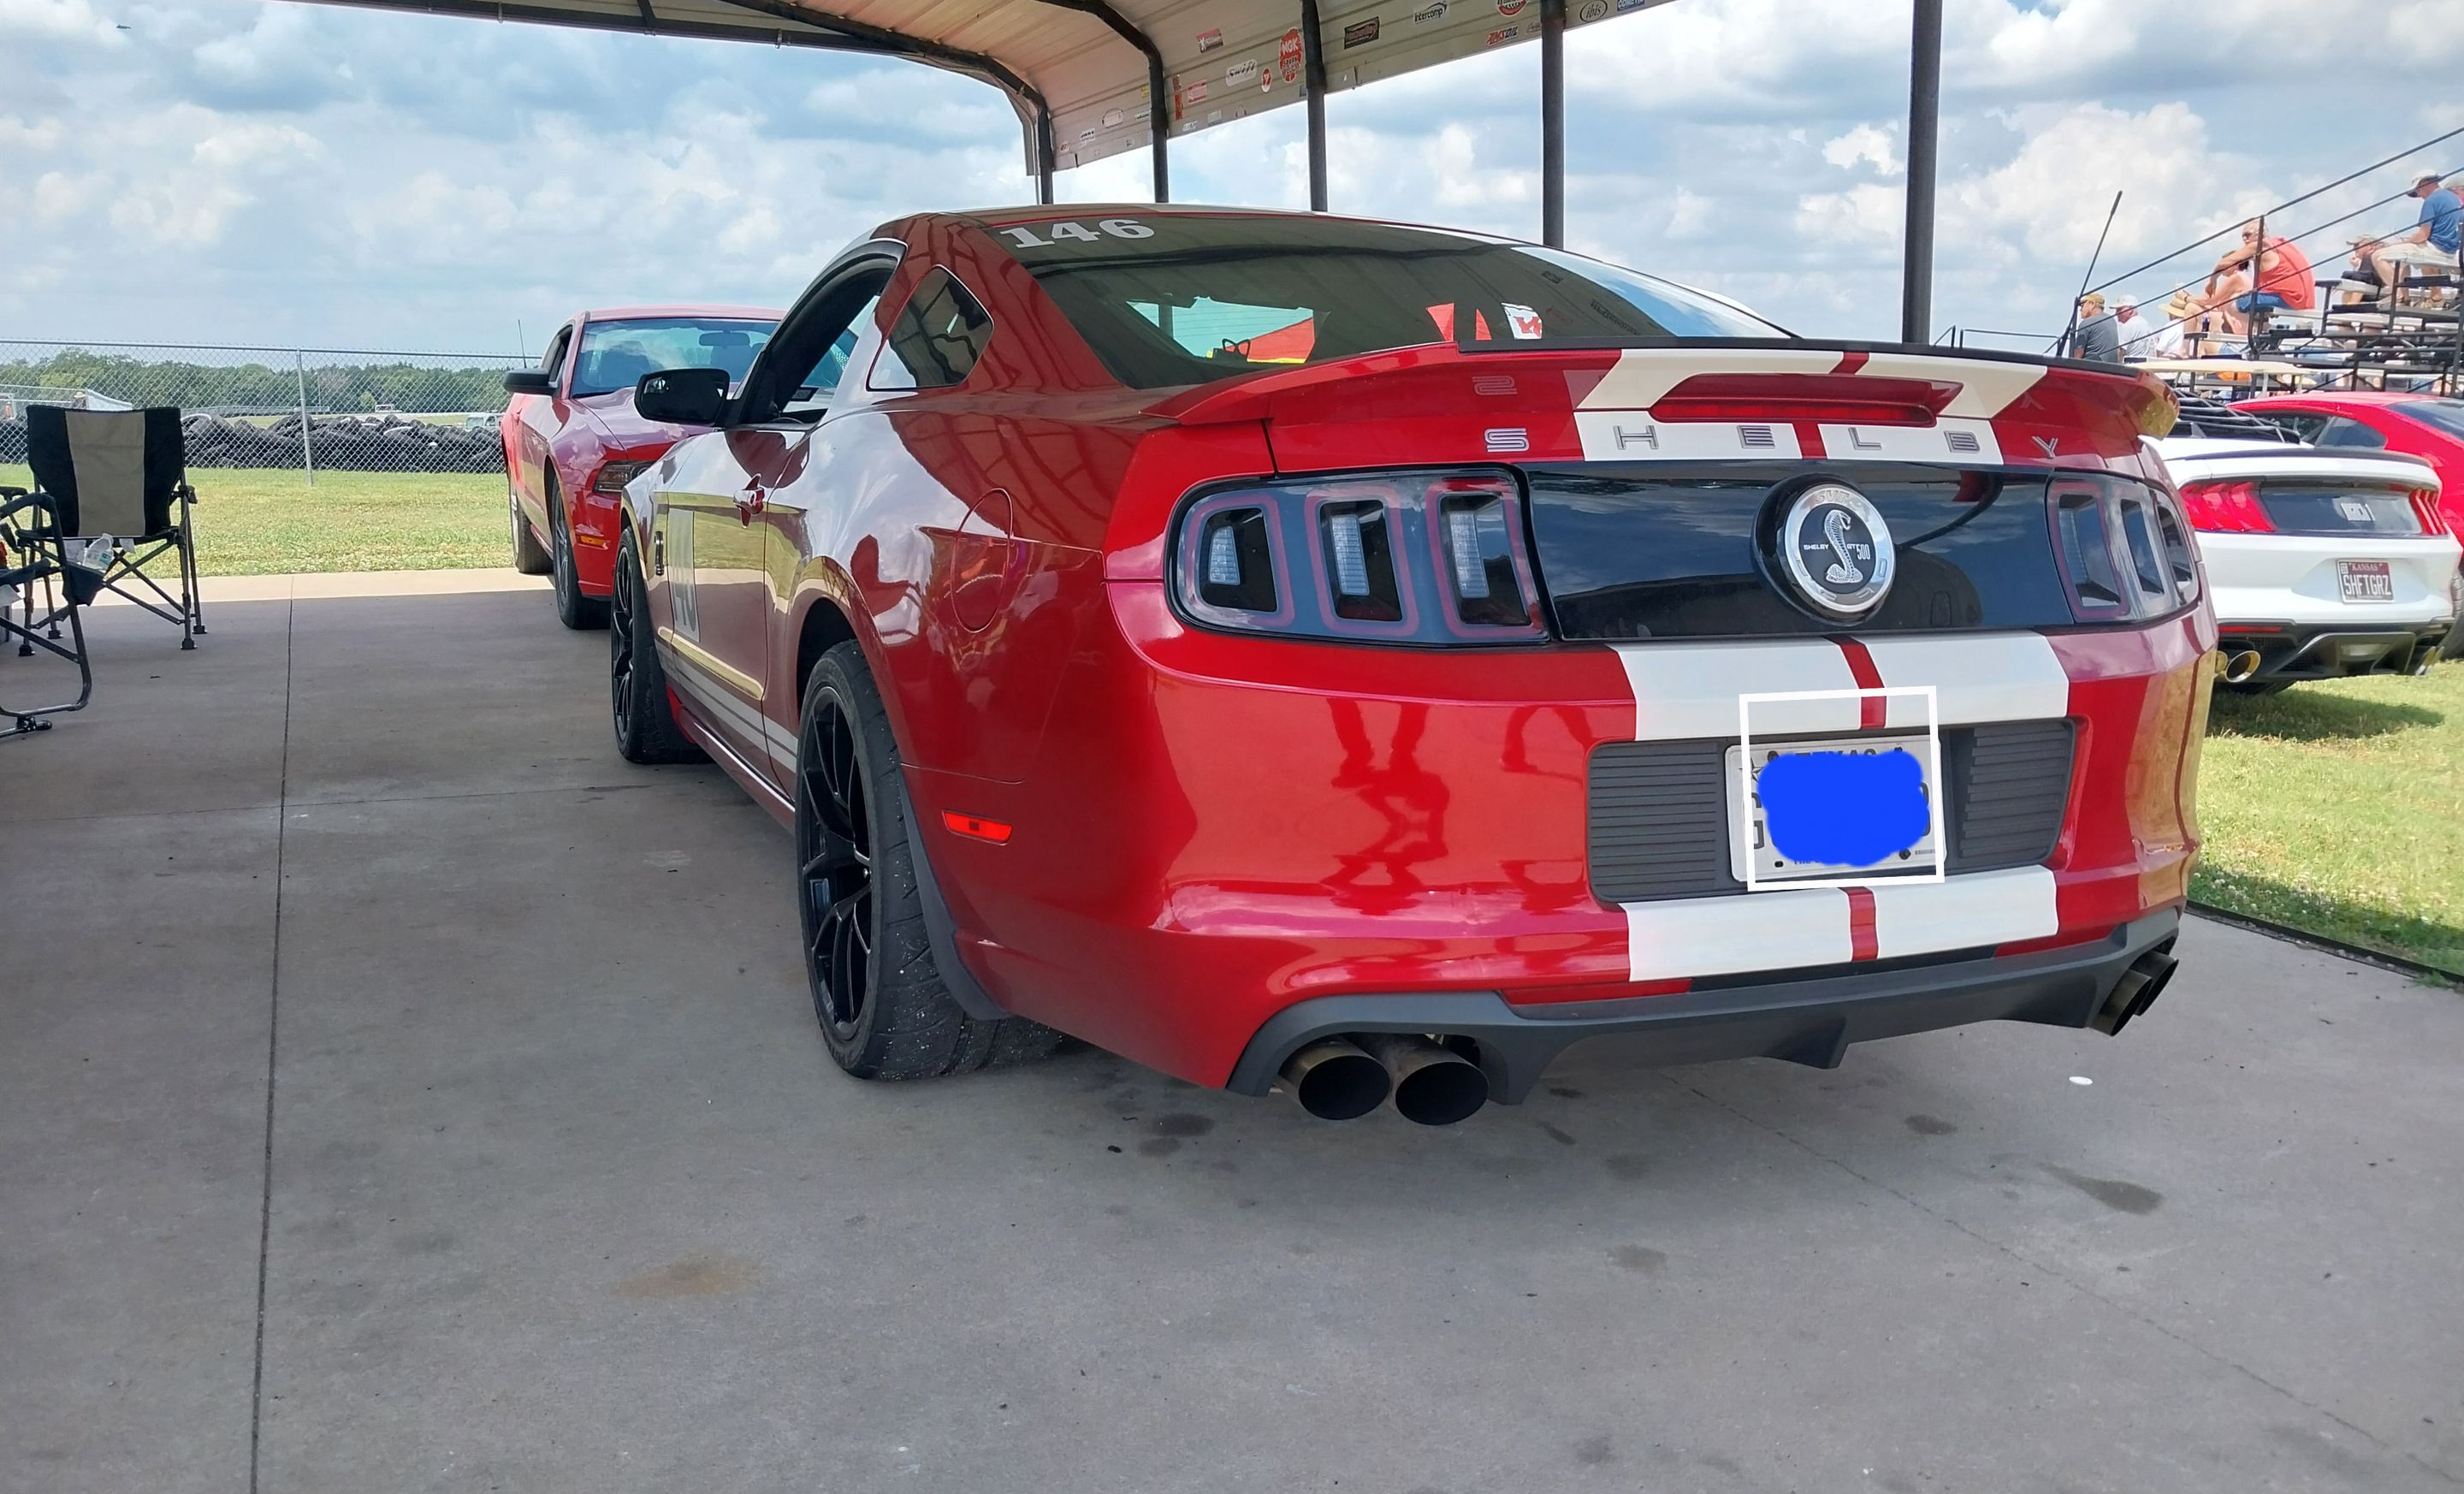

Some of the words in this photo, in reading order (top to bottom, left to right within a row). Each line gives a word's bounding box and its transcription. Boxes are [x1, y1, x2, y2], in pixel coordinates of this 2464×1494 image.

[1414, 8, 1443, 22] Intercomp
[1585, 4, 1602, 19] ibis
[1282, 38, 1299, 55] NGK
[999, 219, 1155, 248] 146
[1484, 424, 2059, 459] SHELBY
[1815, 489, 1851, 503] SVT
[2351, 562, 2378, 572] KANSAS
[2343, 574, 2392, 596] SHFTGRZ
